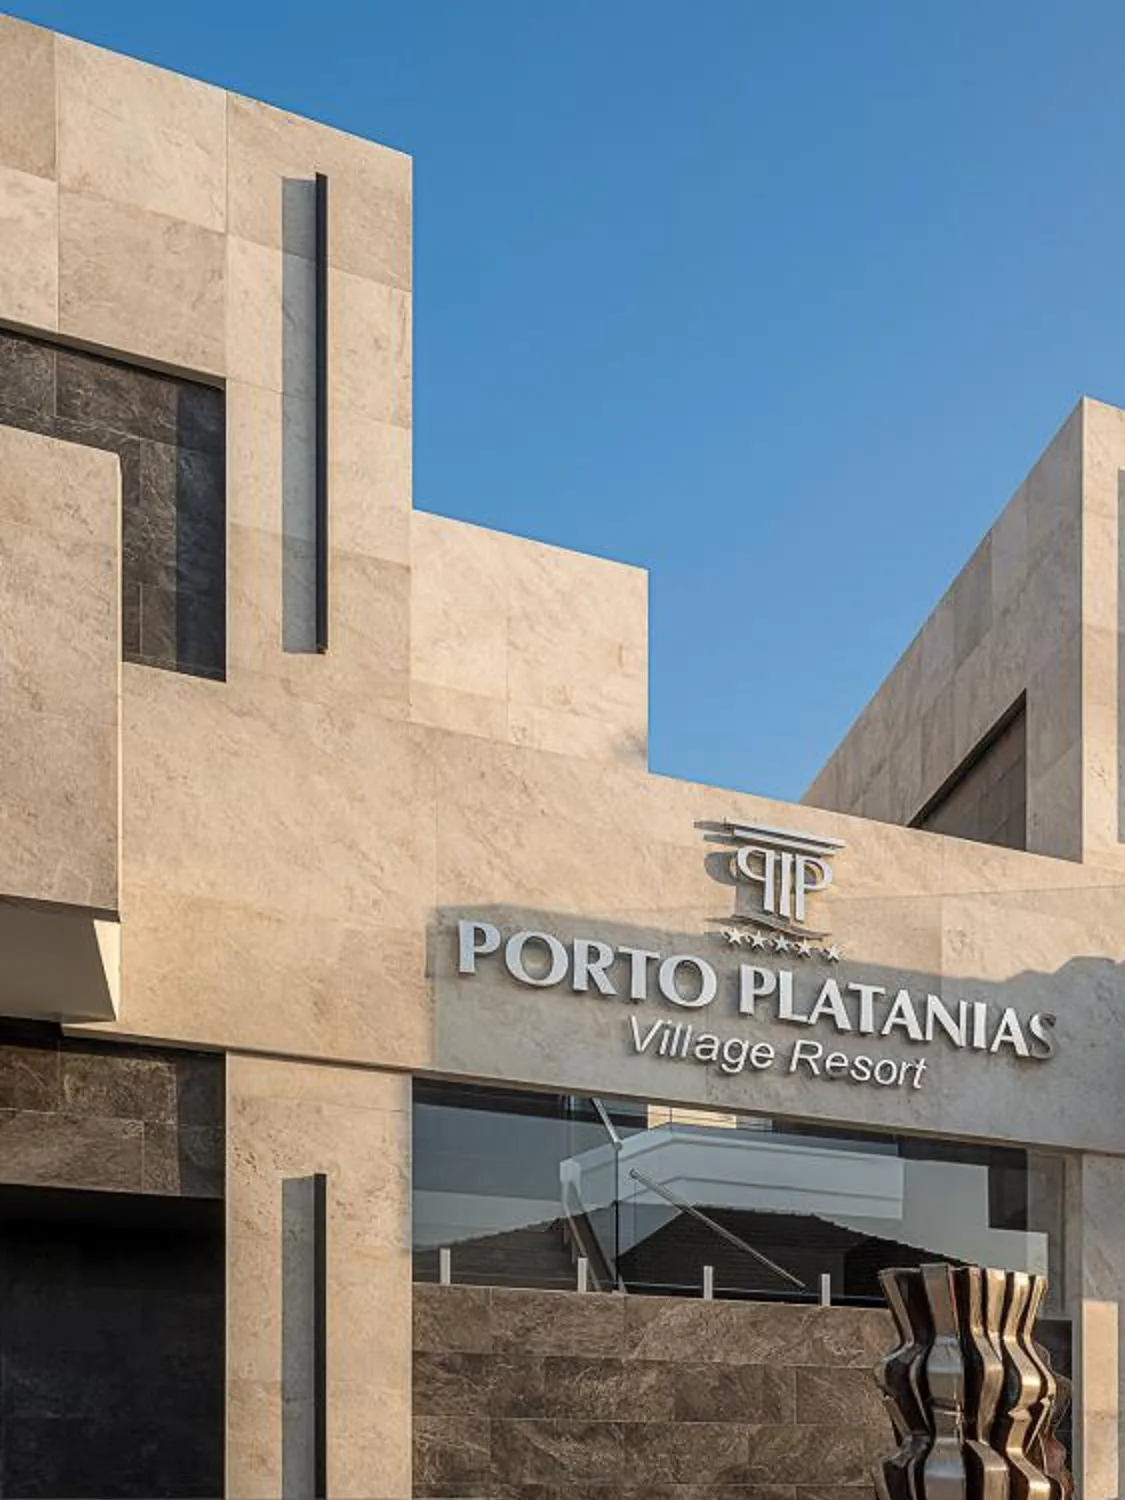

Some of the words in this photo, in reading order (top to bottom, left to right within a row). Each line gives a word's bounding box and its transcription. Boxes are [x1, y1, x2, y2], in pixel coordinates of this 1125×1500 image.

[458, 920, 717, 1008] PORTO
[738, 963, 1057, 1060] PLATANIAS
[629, 1014, 775, 1074] Village
[790, 1038, 928, 1089] Resort
